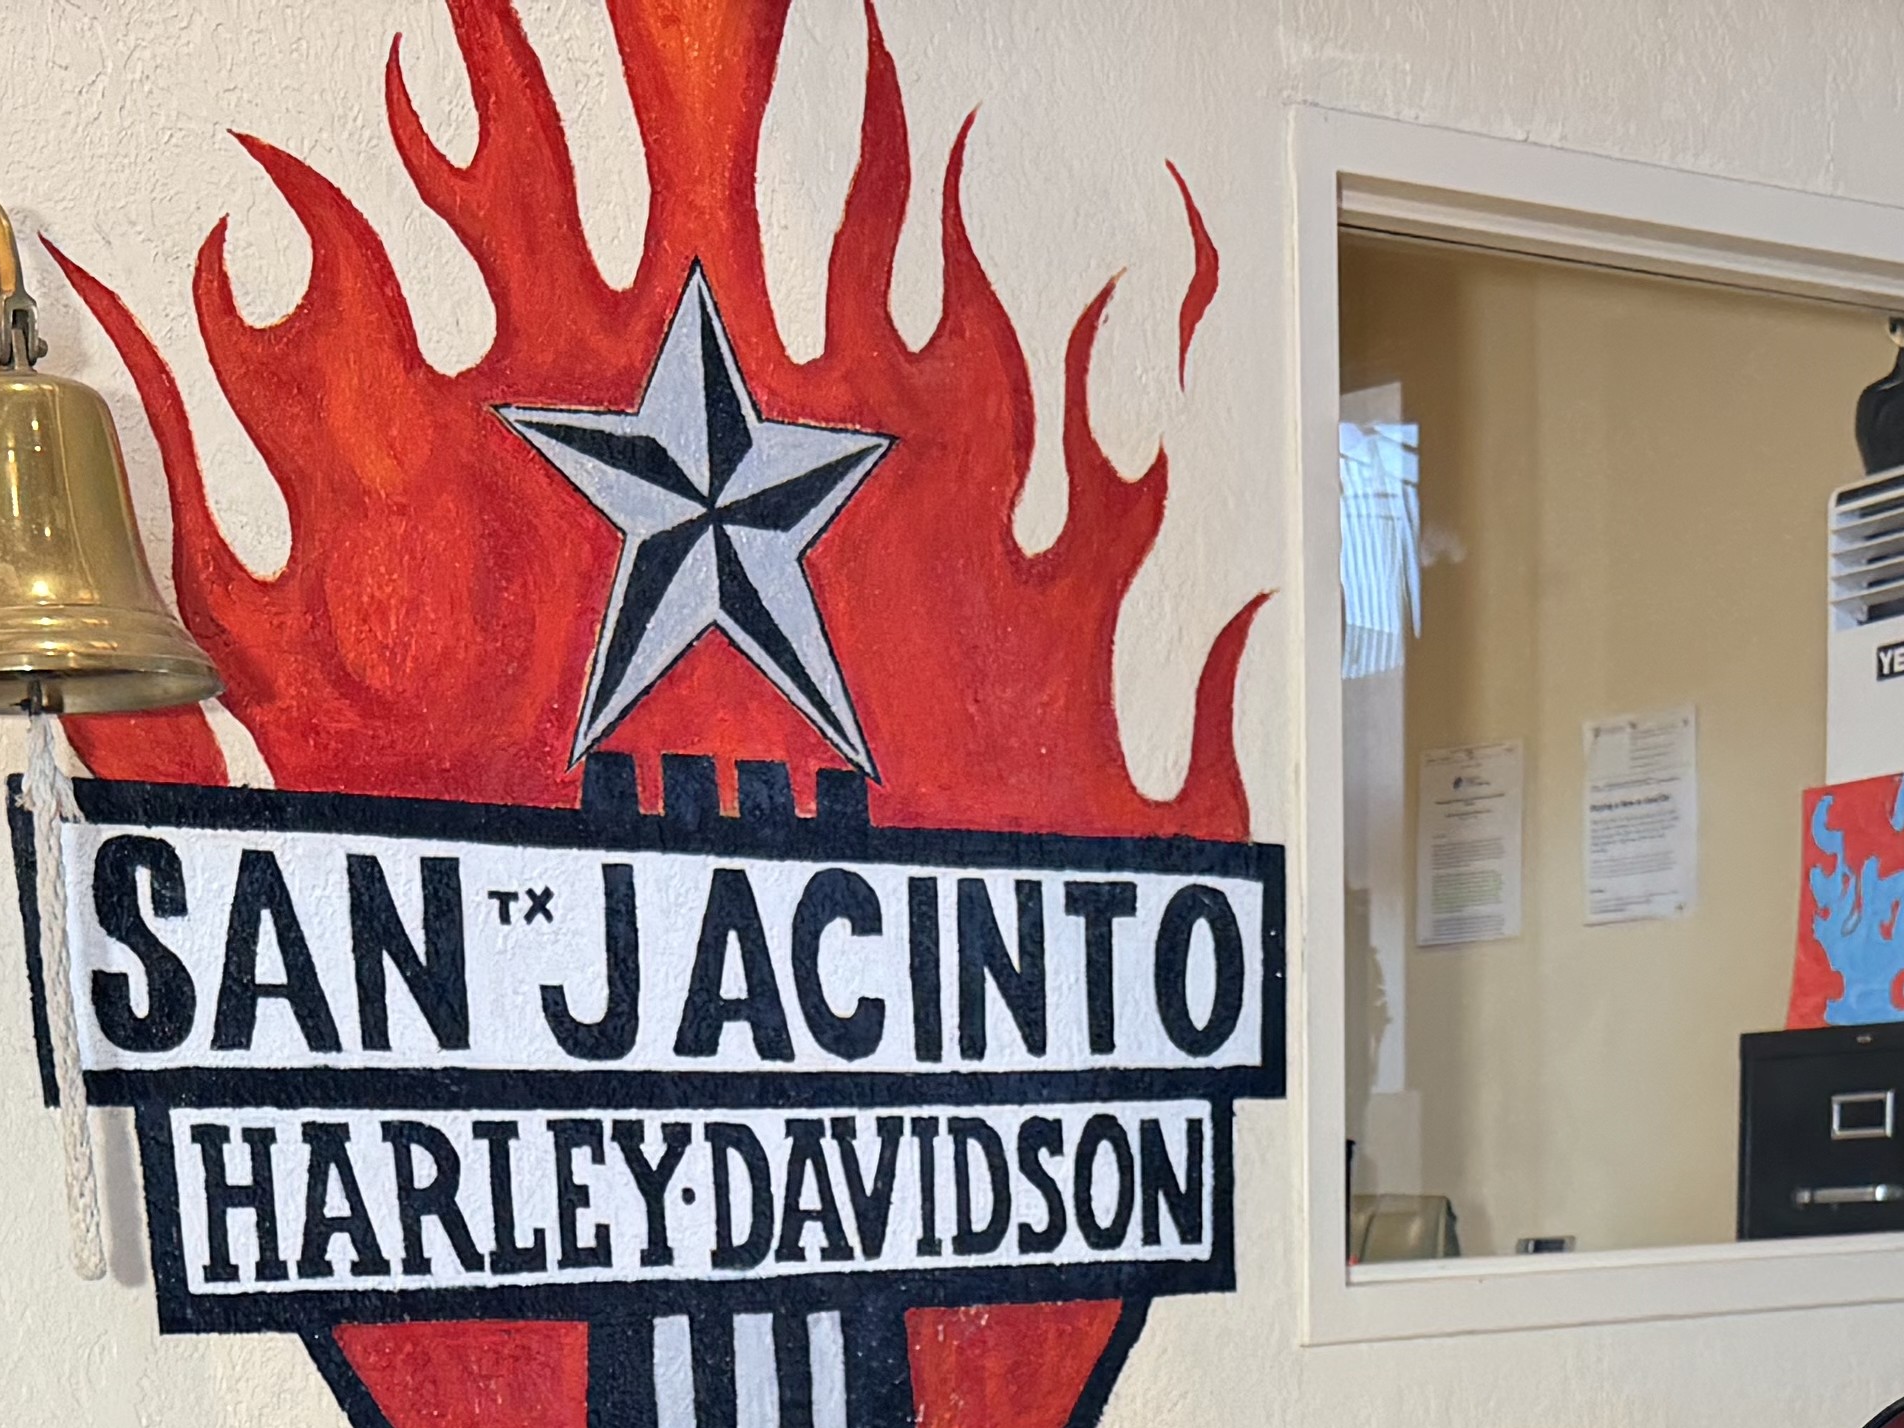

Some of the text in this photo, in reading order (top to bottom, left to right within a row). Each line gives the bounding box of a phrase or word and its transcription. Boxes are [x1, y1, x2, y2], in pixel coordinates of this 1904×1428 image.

[95, 832, 1249, 1064] SAN TX JACINTO
